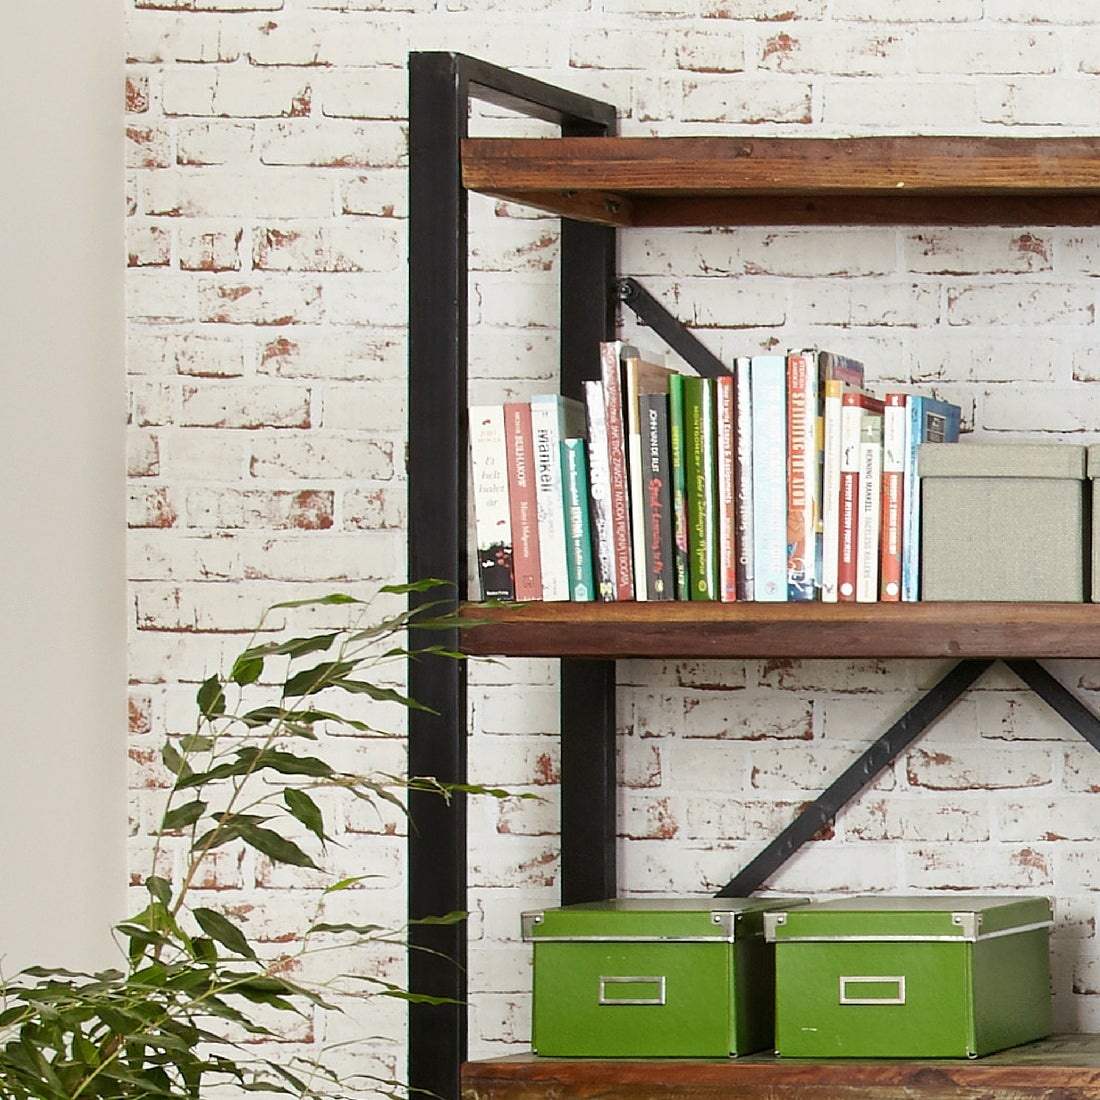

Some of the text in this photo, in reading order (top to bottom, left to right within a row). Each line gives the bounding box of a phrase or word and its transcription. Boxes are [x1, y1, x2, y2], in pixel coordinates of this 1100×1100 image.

[648, 409, 658, 431] JOHN
[649, 431, 658, 446] VAN
[692, 406, 700, 466] MONTGOMERY
[792, 454, 805, 476] THE
[864, 449, 873, 479] HENNING
[793, 477, 805, 507] ATOM
[864, 481, 873, 513] MANKELL
